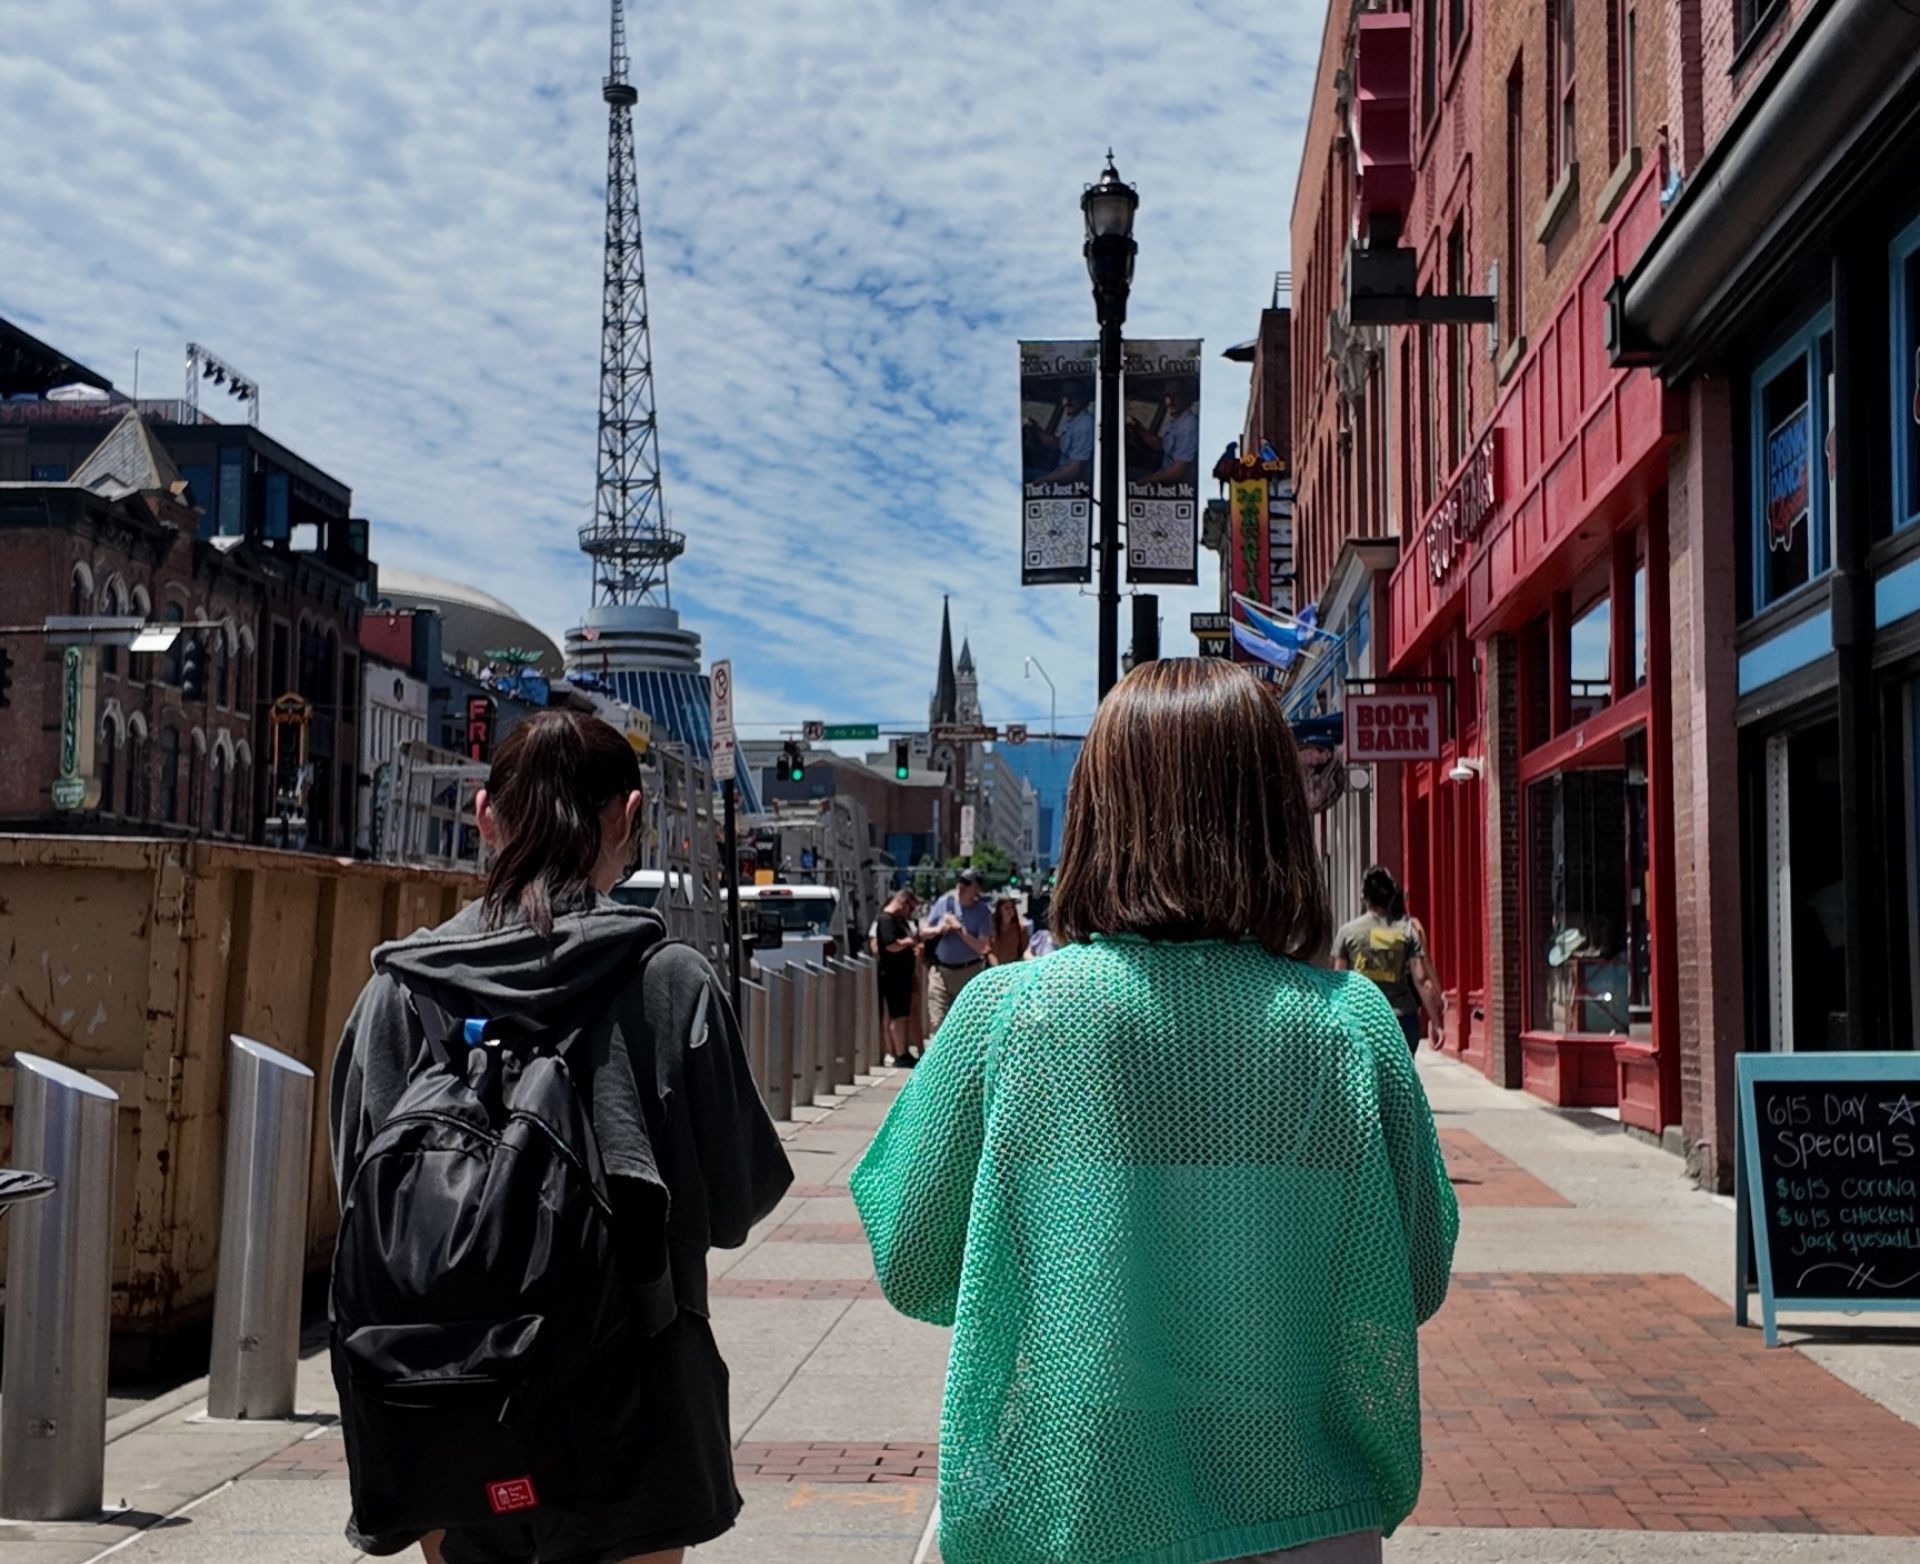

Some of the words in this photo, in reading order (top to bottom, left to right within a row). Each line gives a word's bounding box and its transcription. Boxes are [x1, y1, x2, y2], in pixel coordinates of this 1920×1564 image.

[1055, 355, 1093, 373] Green
[1158, 354, 1196, 373] Green
[1052, 482, 1073, 496] Just
[1128, 482, 1155, 497] That's
[1157, 483, 1177, 497] Just
[1357, 704, 1428, 728] BOOT
[468, 698, 489, 762] FRI
[1357, 728, 1429, 752] BARN
[1766, 1093, 1812, 1127] 615
